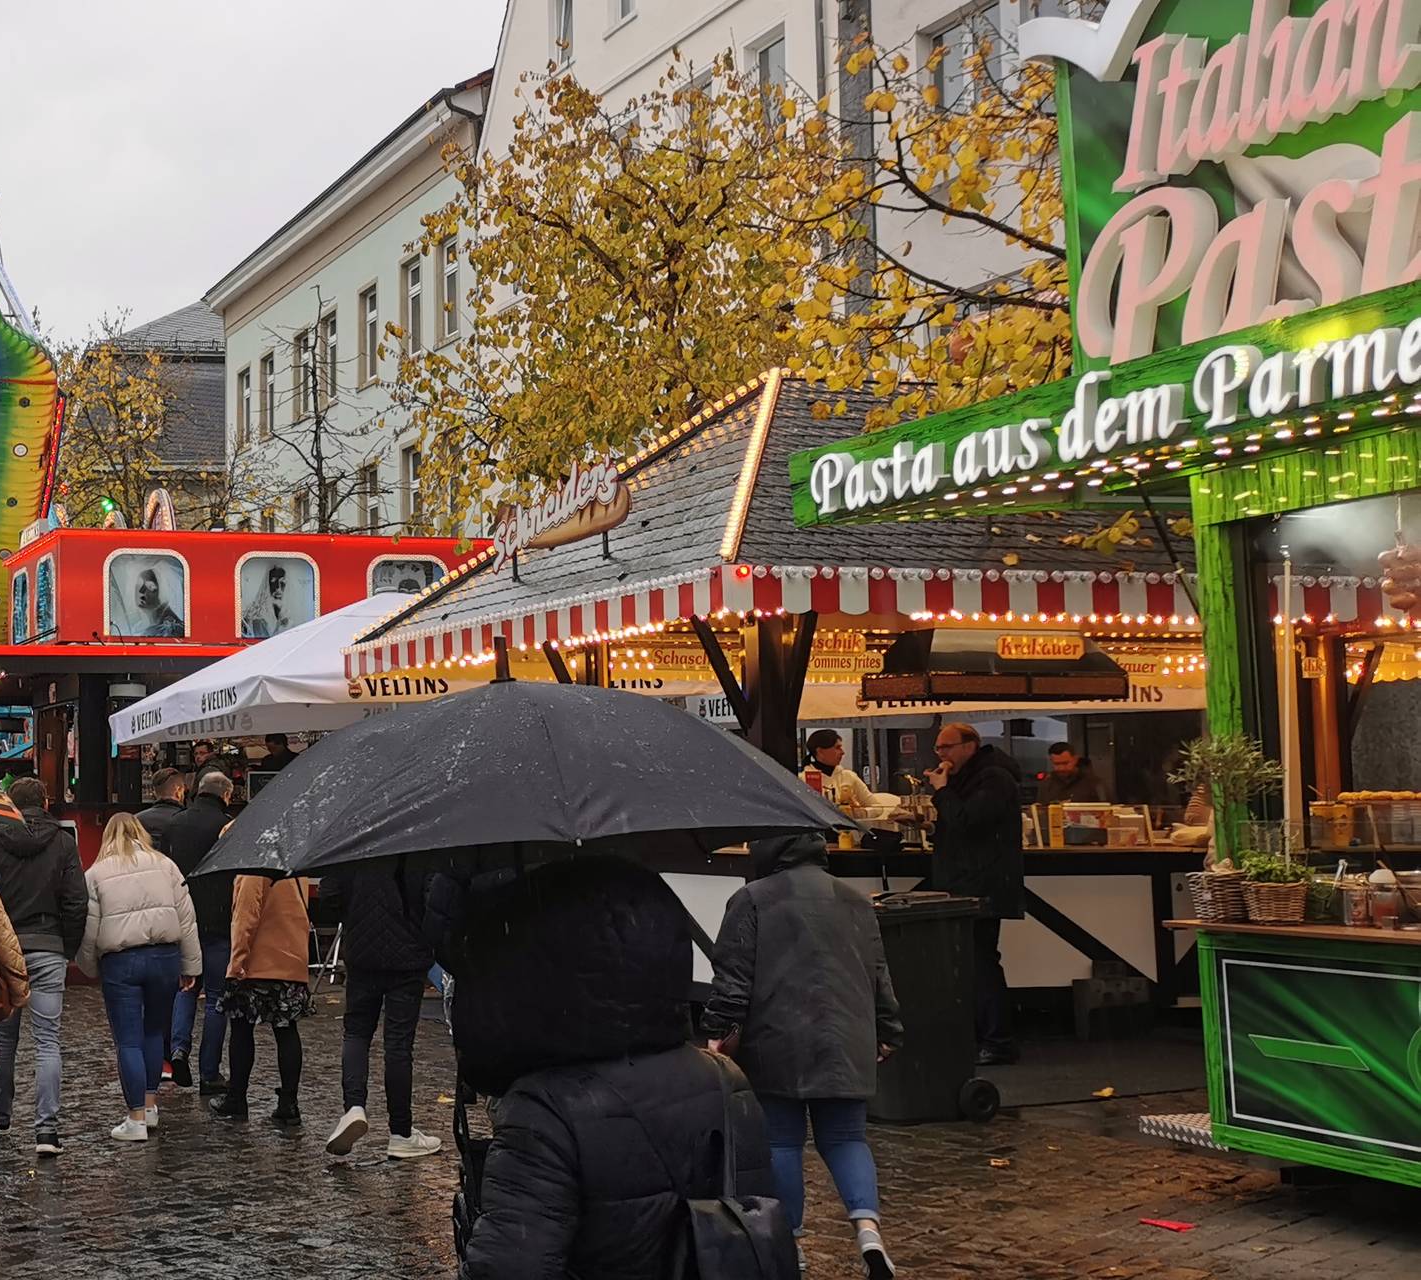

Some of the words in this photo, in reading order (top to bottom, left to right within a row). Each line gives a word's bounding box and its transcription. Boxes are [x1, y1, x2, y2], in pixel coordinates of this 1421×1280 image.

[1111, 0, 1421, 193] Italian
[810, 441, 951, 515] Pasta
[953, 417, 1052, 487] aus
[1058, 370, 1192, 463] dem
[493, 453, 619, 575] Schneider's
[1000, 637, 1081, 656] Krakauer
[853, 654, 881, 671] frites
[206, 686, 237, 712] VELTINS
[365, 677, 449, 697] VELTINS
[136, 707, 162, 731] VELTINS
